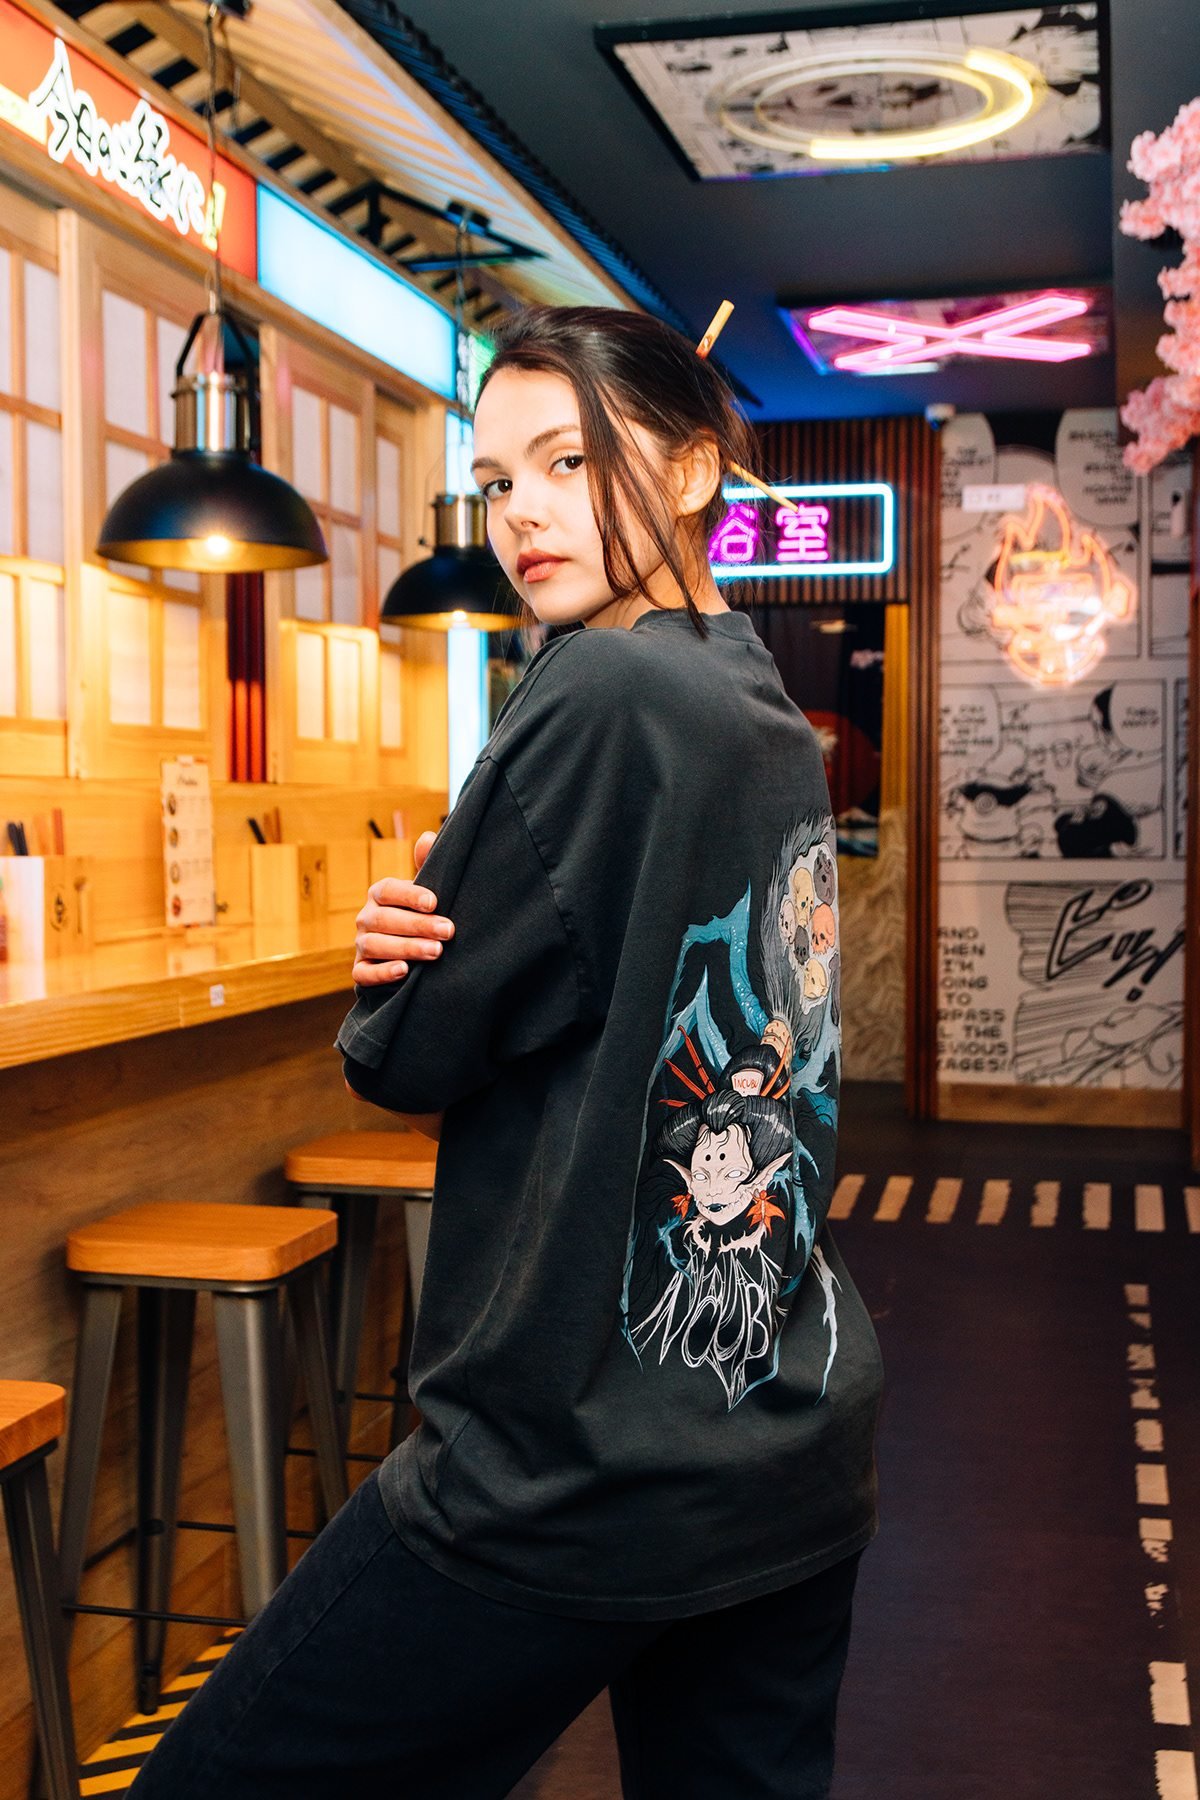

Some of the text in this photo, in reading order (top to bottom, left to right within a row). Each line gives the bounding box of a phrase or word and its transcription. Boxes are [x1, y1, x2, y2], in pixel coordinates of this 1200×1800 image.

[938, 943, 986, 957] HEN
[944, 959, 976, 974] I'M
[938, 975, 989, 991] OING
[945, 991, 972, 1006] TO
[963, 1024, 1000, 1038] THE
